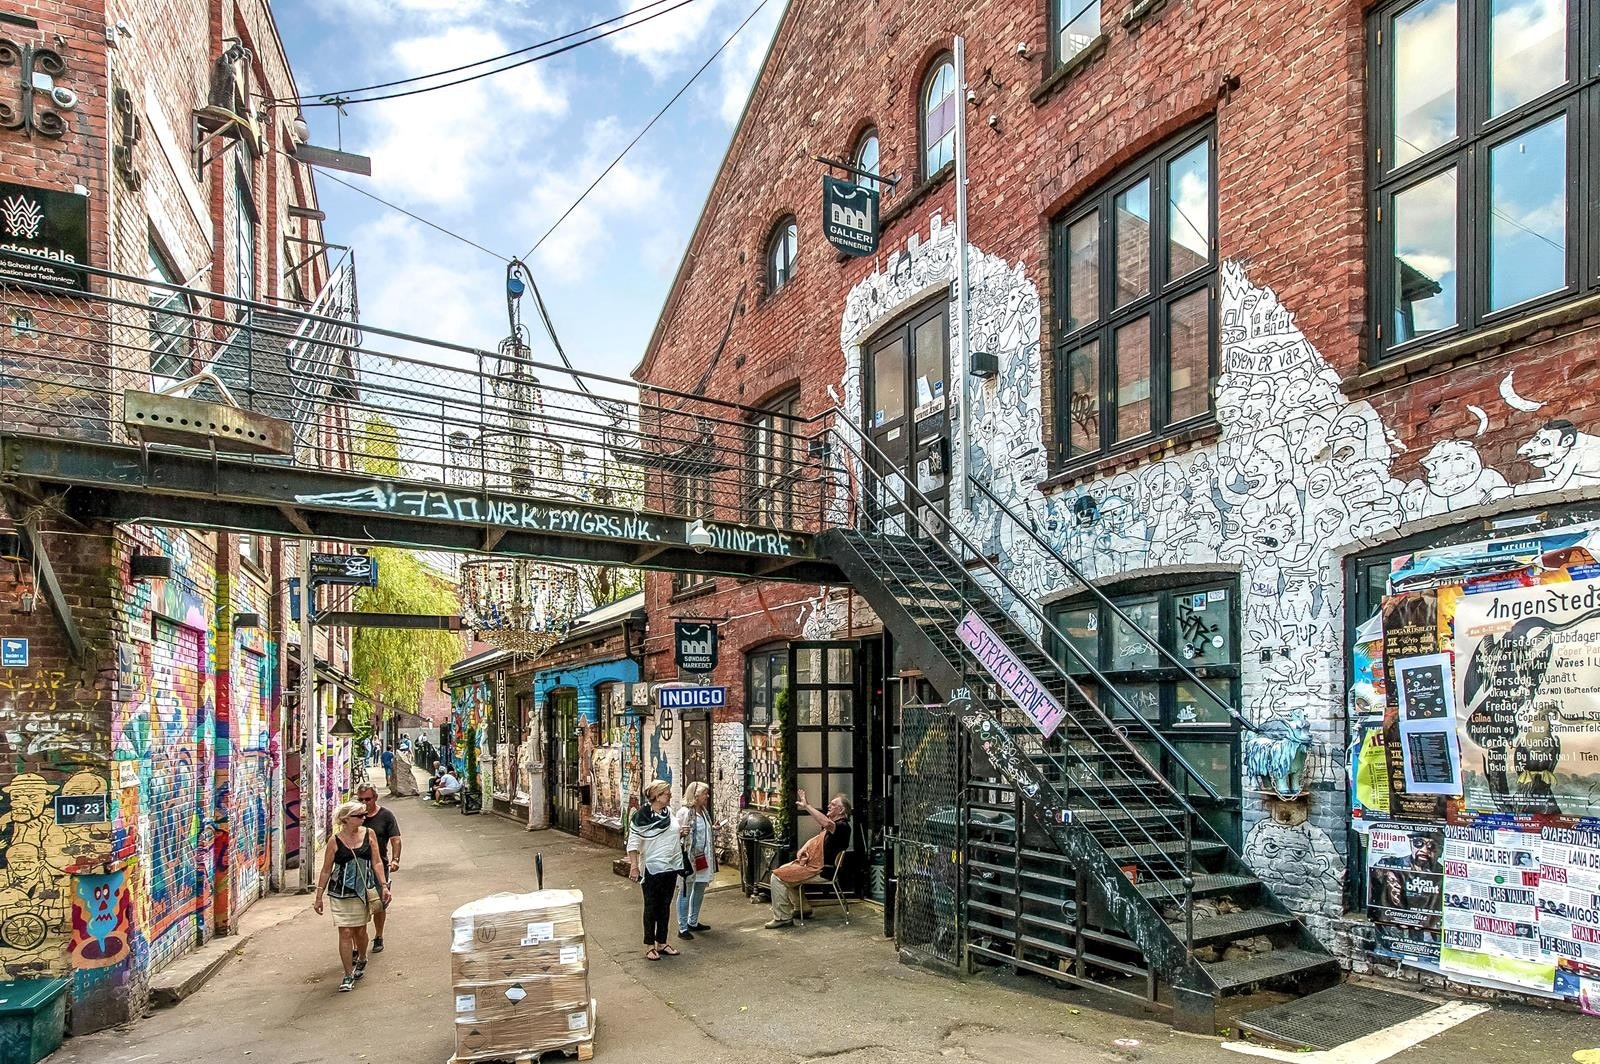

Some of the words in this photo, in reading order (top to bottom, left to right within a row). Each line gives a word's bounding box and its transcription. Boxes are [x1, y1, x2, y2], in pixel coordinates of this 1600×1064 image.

[830, 226, 873, 244] GALLERI
[829, 236, 873, 252] BRENNERIET
[7, 261, 31, 270] School
[38, 273, 75, 285] Technology
[1283, 624, 1318, 647] 7UP
[1555, 657, 1584, 668] Waves
[969, 630, 1059, 725] STRYKEJERNET
[663, 690, 722, 706] INDIGO
[1471, 725, 1501, 733] Rulefinn
[1520, 736, 1560, 748] Øyanatt
[1517, 752, 1526, 762] By
[1530, 751, 1552, 762] Night
[62, 804, 80, 815] ID:
[84, 803, 99, 815] 23
[1372, 832, 1406, 842] William
[1445, 825, 1494, 844] ØYAFESTIVALEN
[1372, 840, 1390, 849] Bell
[1467, 846, 1484, 860] LANA
[1485, 848, 1496, 862] DEL
[1498, 850, 1512, 864] REY
[1568, 850, 1587, 867] LANA
[1445, 861, 1467, 877] PIXIES
[1540, 865, 1567, 884] PIXIES
[1406, 881, 1439, 893] bryant
[1412, 877, 1433, 887] don
[1522, 872, 1539, 887] THE
[1489, 886, 1506, 901] LARS
[1507, 889, 1534, 905] VAULAR
[1385, 909, 1428, 920] Cosmopolite
[1469, 899, 1496, 915] MIGOS
[1566, 905, 1599, 924] MIGOS
[1474, 916, 1490, 932] RYAN
[1492, 919, 1514, 936] ADAMS
[1573, 924, 1590, 942] RYAN
[1445, 929, 1457, 944] THE
[1460, 931, 1481, 948] SHINS
[1541, 935, 1555, 951] THE
[1557, 938, 1580, 957] SHINS
